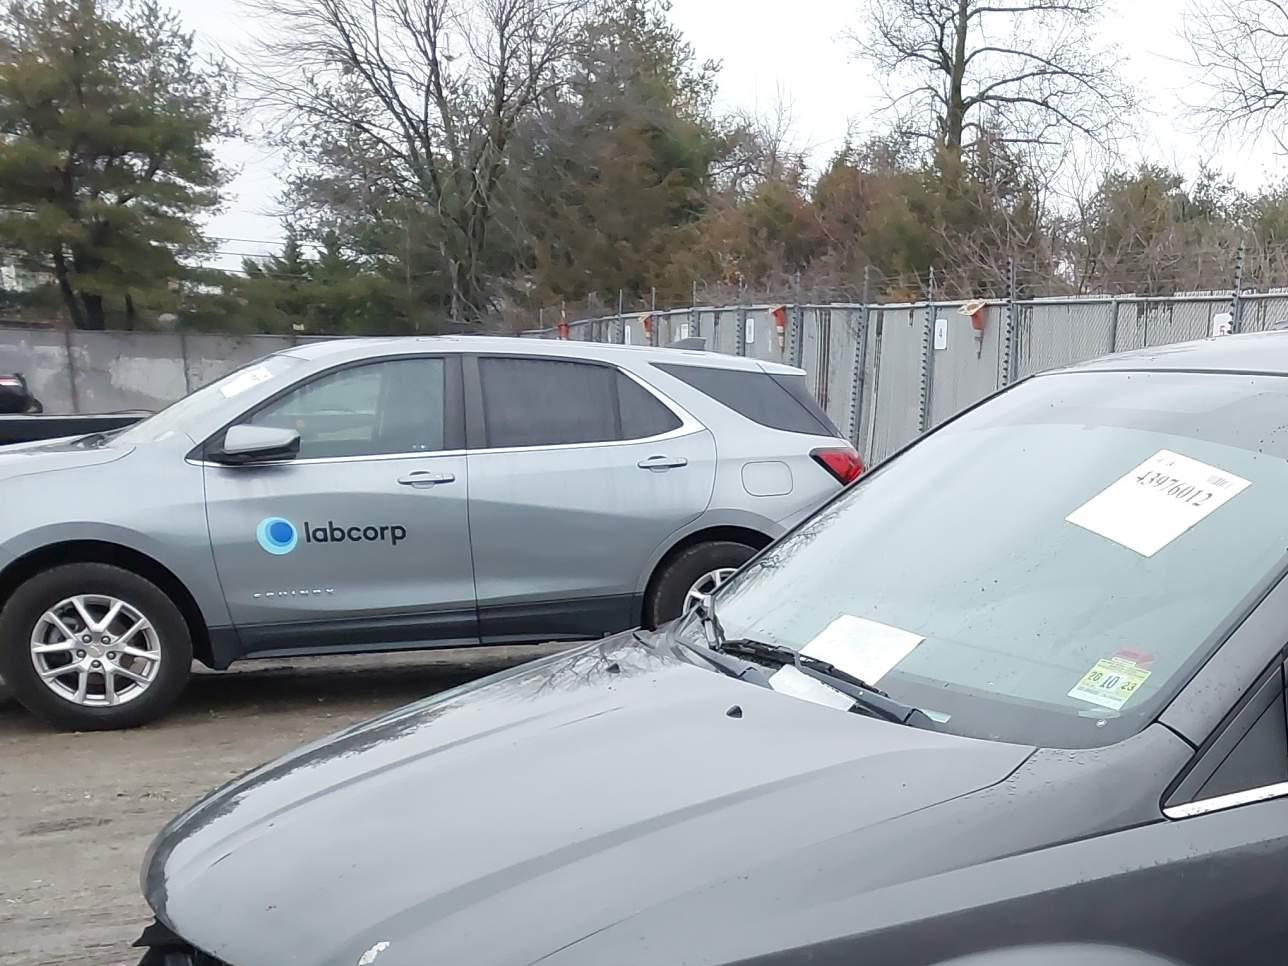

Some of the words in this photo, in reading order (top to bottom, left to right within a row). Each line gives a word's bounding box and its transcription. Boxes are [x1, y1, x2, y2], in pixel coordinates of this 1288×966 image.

[1136, 471, 1213, 506] 43976012
[304, 520, 407, 546] labcorp
[1099, 675, 1121, 689] 10
